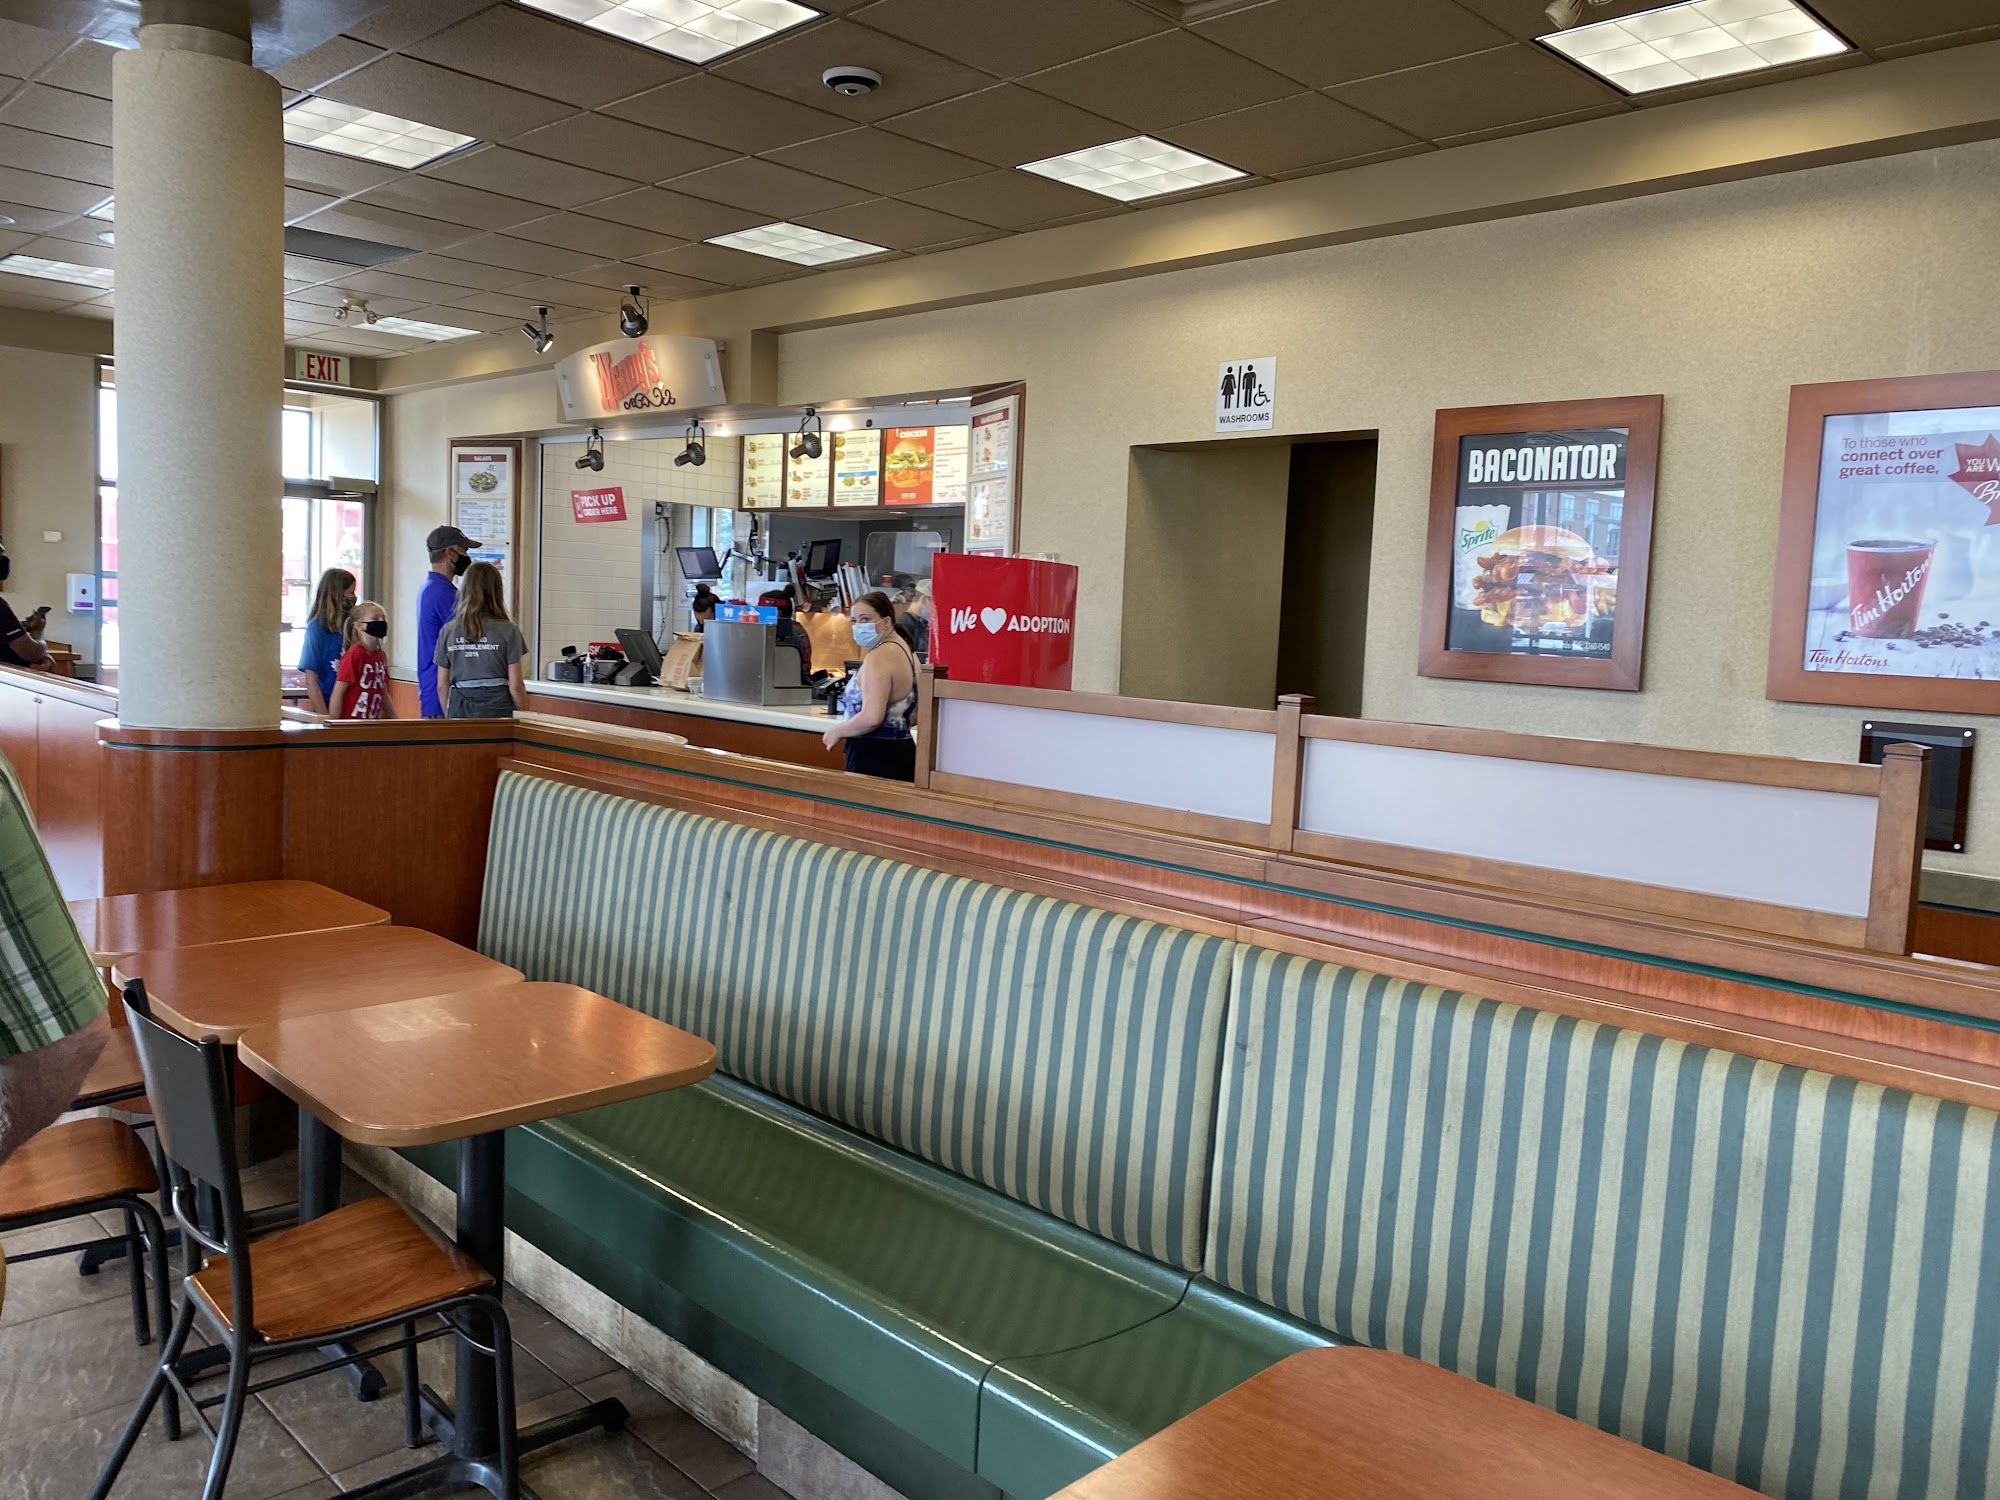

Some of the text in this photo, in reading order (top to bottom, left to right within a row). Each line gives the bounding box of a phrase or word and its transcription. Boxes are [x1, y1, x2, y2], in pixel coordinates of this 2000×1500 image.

[306, 353, 341, 382] EXIT
[1219, 412, 1270, 424] WASHROOMS
[1842, 436, 1928, 449] To those who
[1840, 448, 1944, 462] connect over
[1966, 458, 1986, 466] YOU
[1468, 443, 1618, 484] BACONATOR
[1838, 462, 1940, 479] great coffee,
[1966, 465, 1985, 473] ARE
[580, 493, 616, 507] PICK UP
[600, 506, 619, 515] HERE
[1461, 528, 1495, 548] Sprite
[950, 605, 1071, 635] We ADOPTION
[1850, 603, 1881, 630] Tim
[1809, 649, 1889, 667] Tim Hortons
